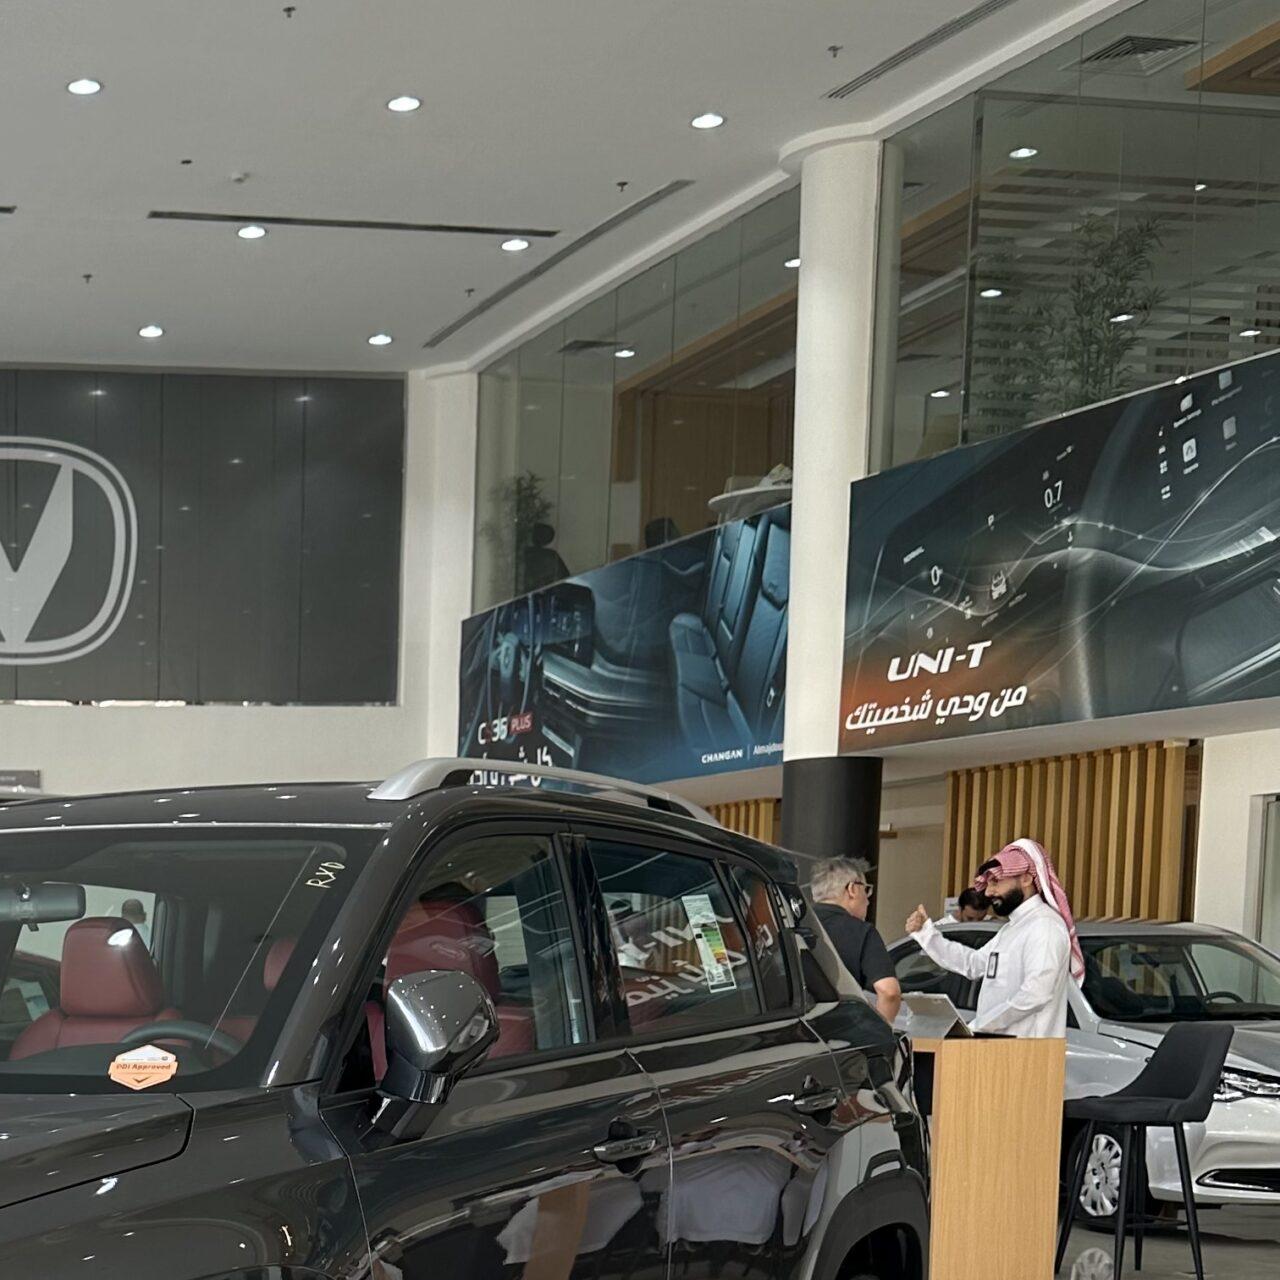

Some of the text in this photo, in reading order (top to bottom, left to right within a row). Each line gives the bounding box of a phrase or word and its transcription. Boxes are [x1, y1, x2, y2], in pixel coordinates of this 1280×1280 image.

[1044, 480, 1063, 508] 0.7
[887, 640, 992, 682] UNI-T
[845, 685, 1028, 734] من وحي شخصيتك
[701, 748, 743, 764] CHANGAN
[132, 1063, 171, 1071] Approved
